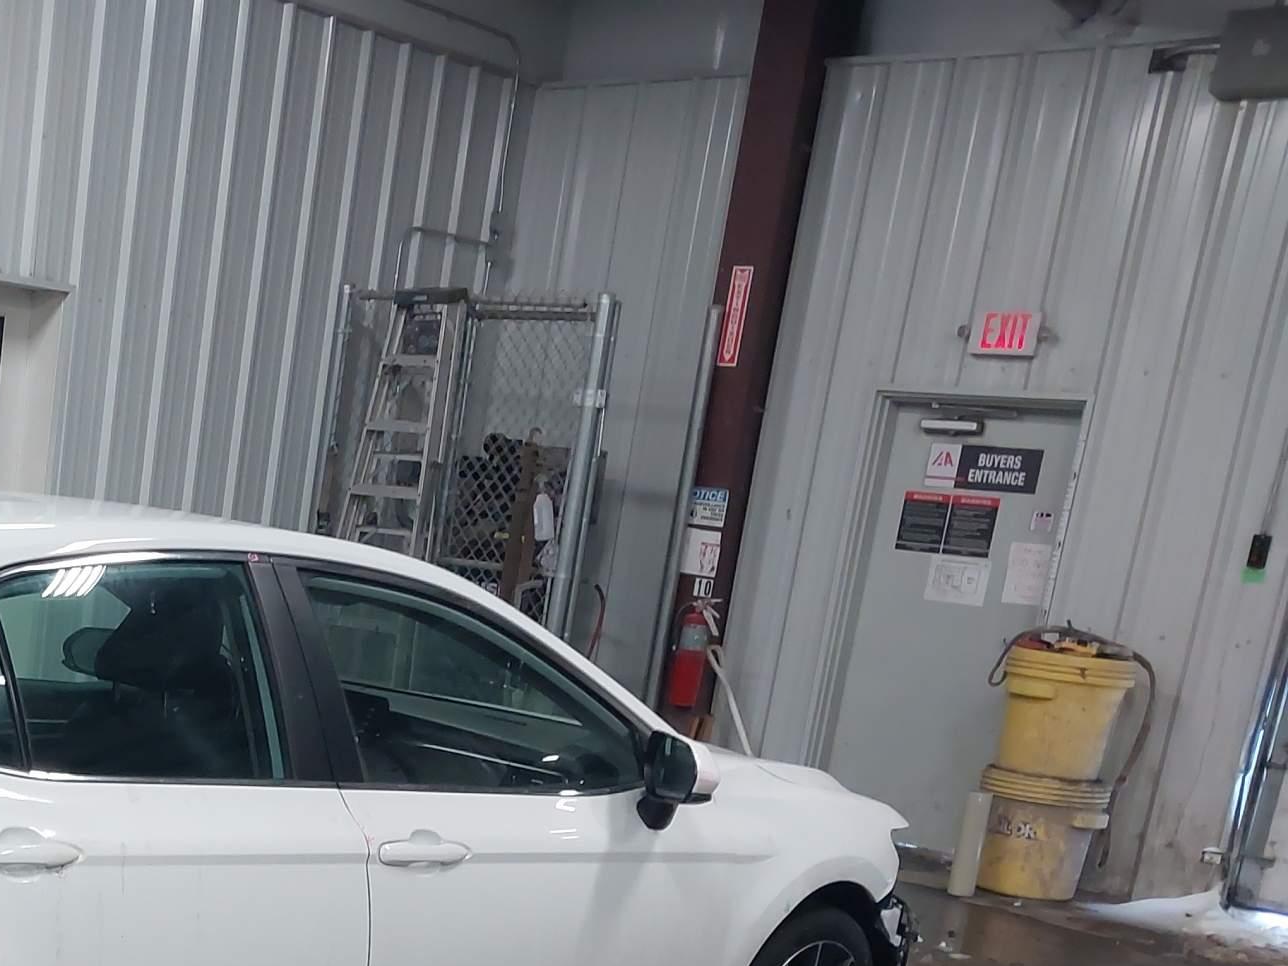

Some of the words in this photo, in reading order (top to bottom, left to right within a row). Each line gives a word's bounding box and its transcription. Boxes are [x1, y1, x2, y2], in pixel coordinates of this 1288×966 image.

[979, 312, 1033, 350] EXIT
[977, 453, 1023, 469] BUYERS
[967, 468, 1026, 486] ENTRANCE
[696, 579, 713, 597] 10
